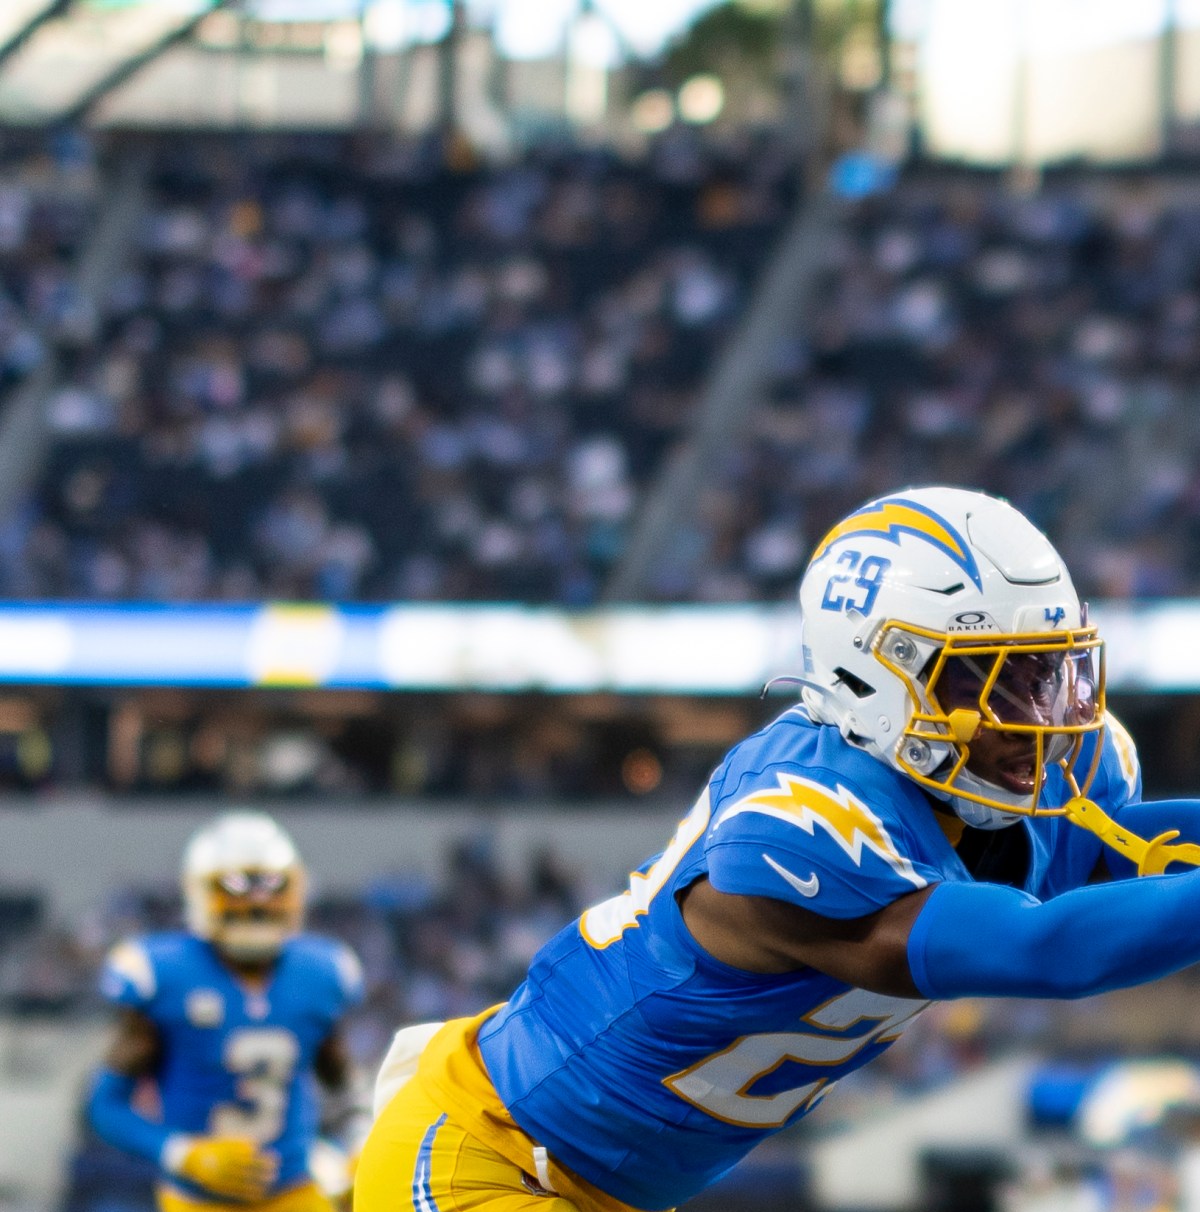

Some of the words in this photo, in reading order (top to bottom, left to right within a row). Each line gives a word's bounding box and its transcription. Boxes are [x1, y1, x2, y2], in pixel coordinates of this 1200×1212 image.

[821, 550, 892, 618] 29
[948, 624, 994, 632] OAKLEY
[210, 1028, 299, 1146] 3
